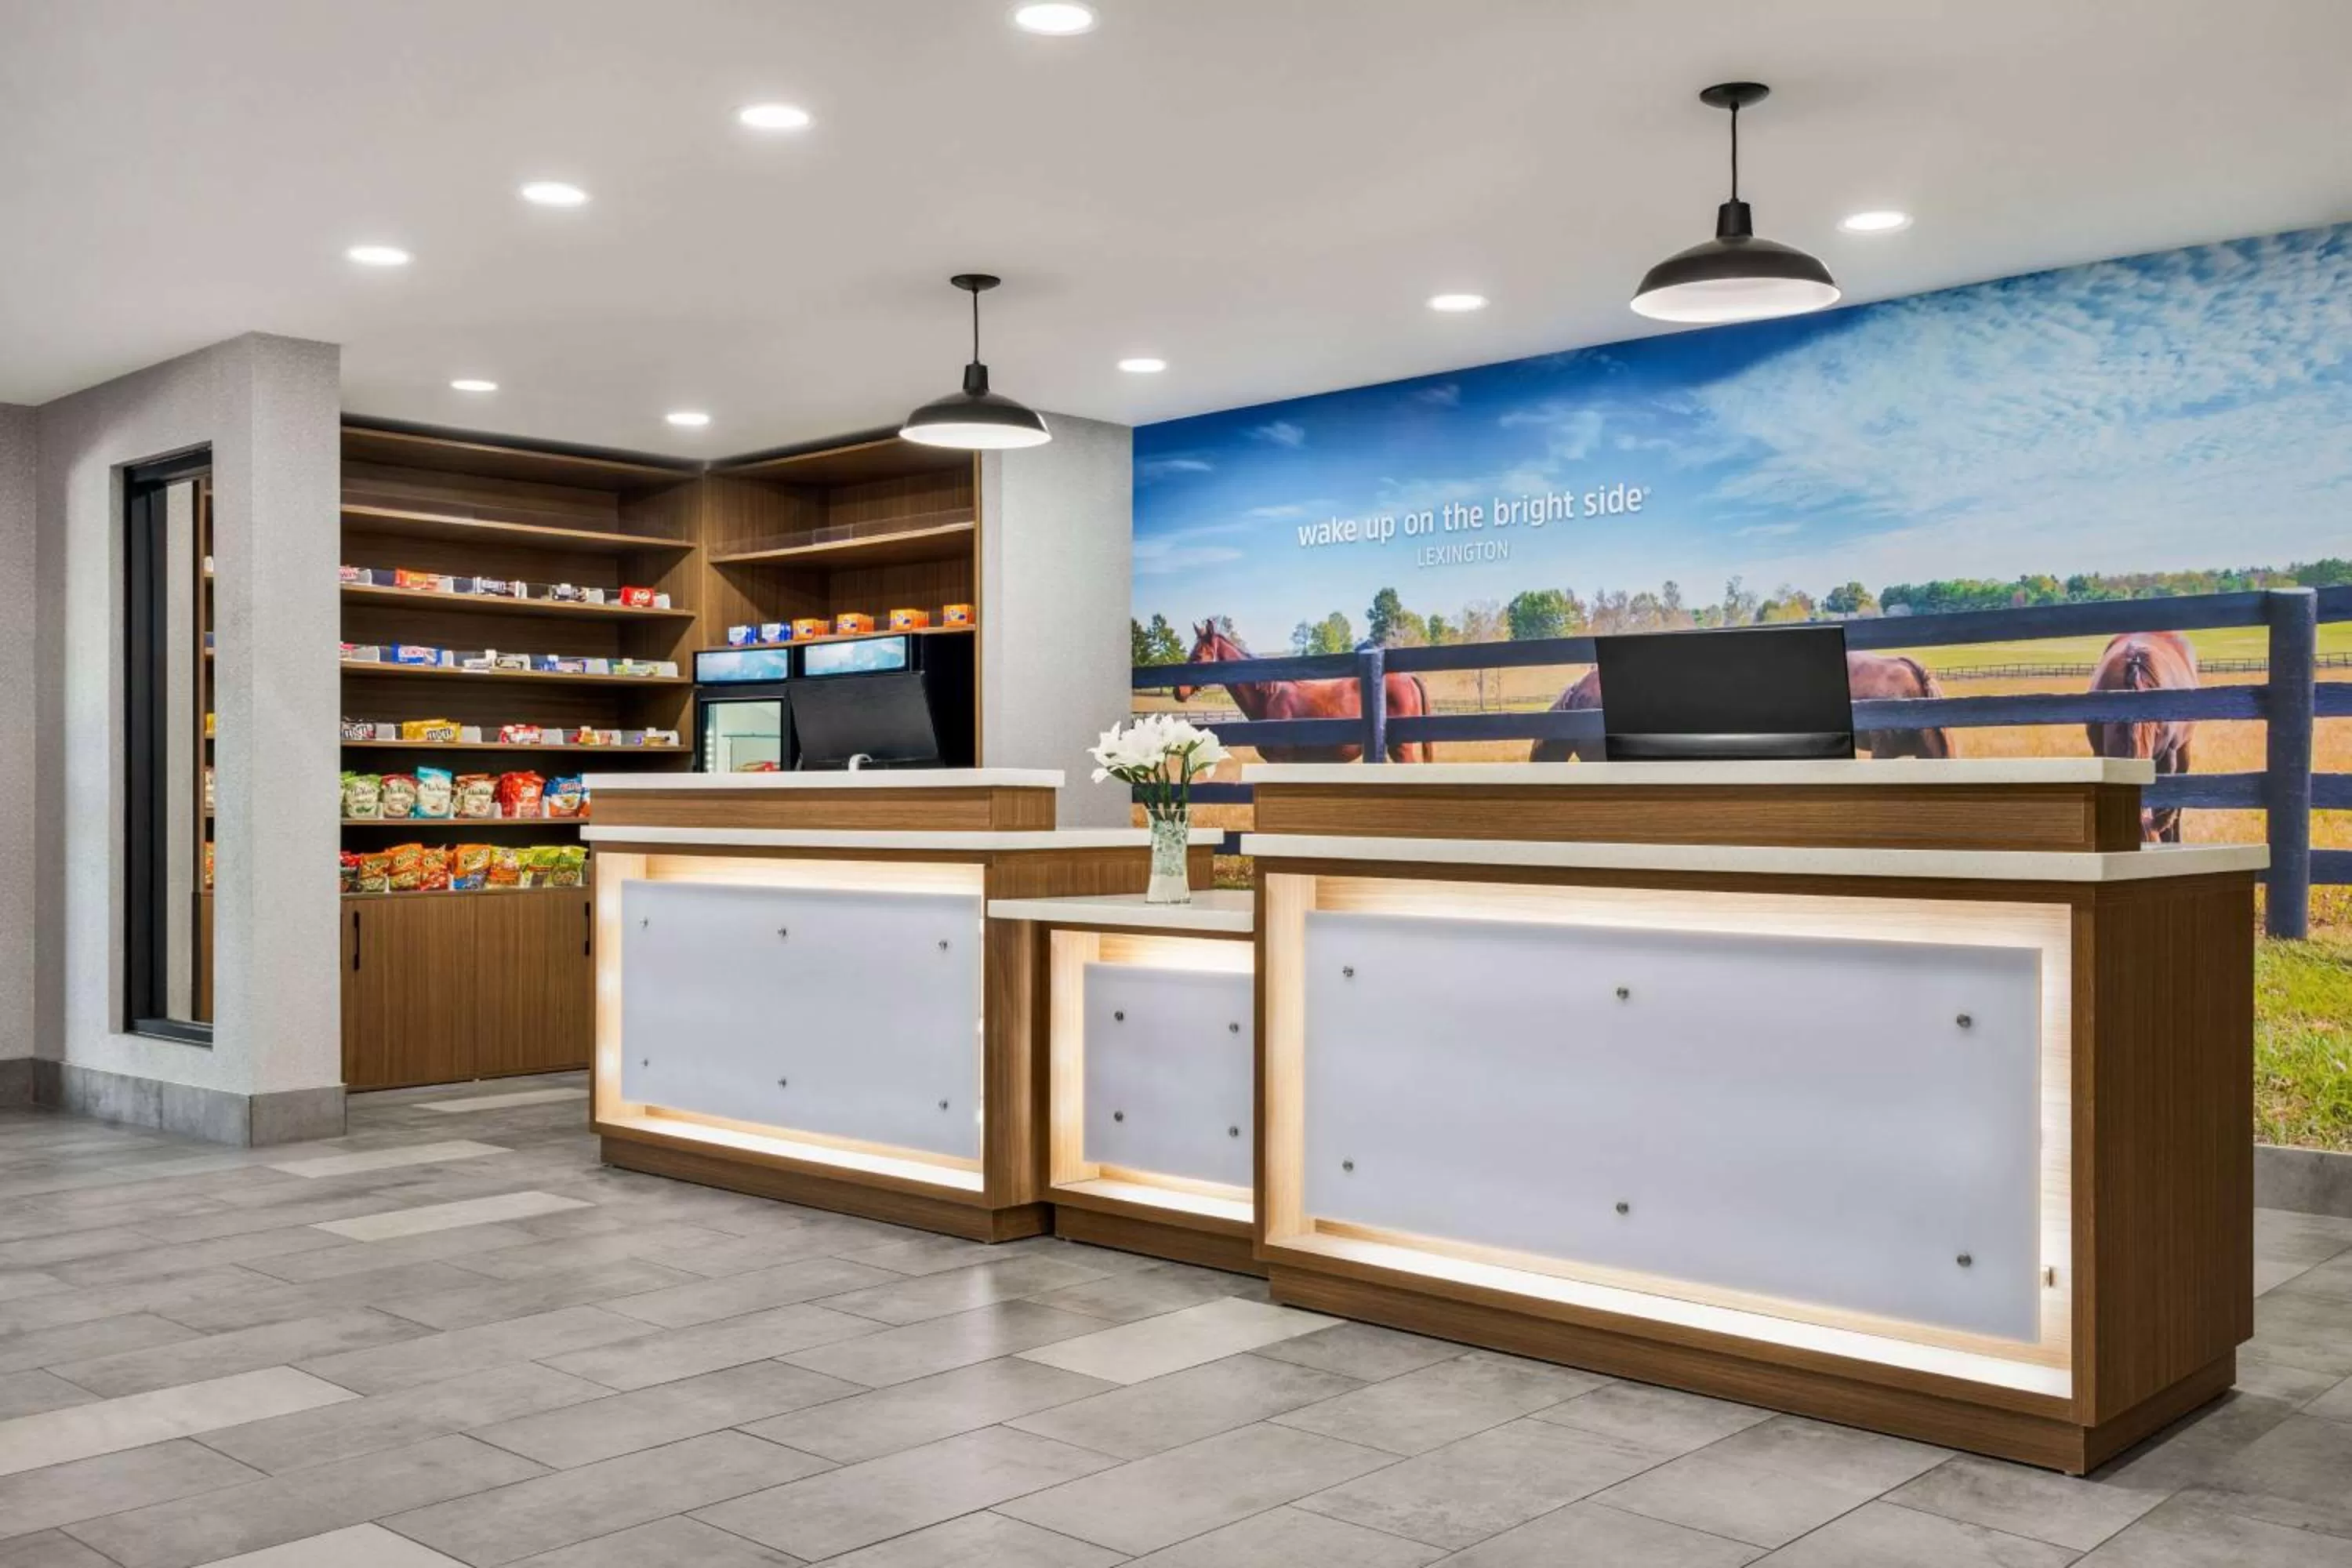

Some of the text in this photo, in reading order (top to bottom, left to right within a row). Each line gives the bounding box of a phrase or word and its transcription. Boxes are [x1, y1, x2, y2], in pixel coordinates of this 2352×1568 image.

[1298, 482, 1643, 546] wake up on the bright side
[1417, 539, 1508, 567] LEXINGTON
